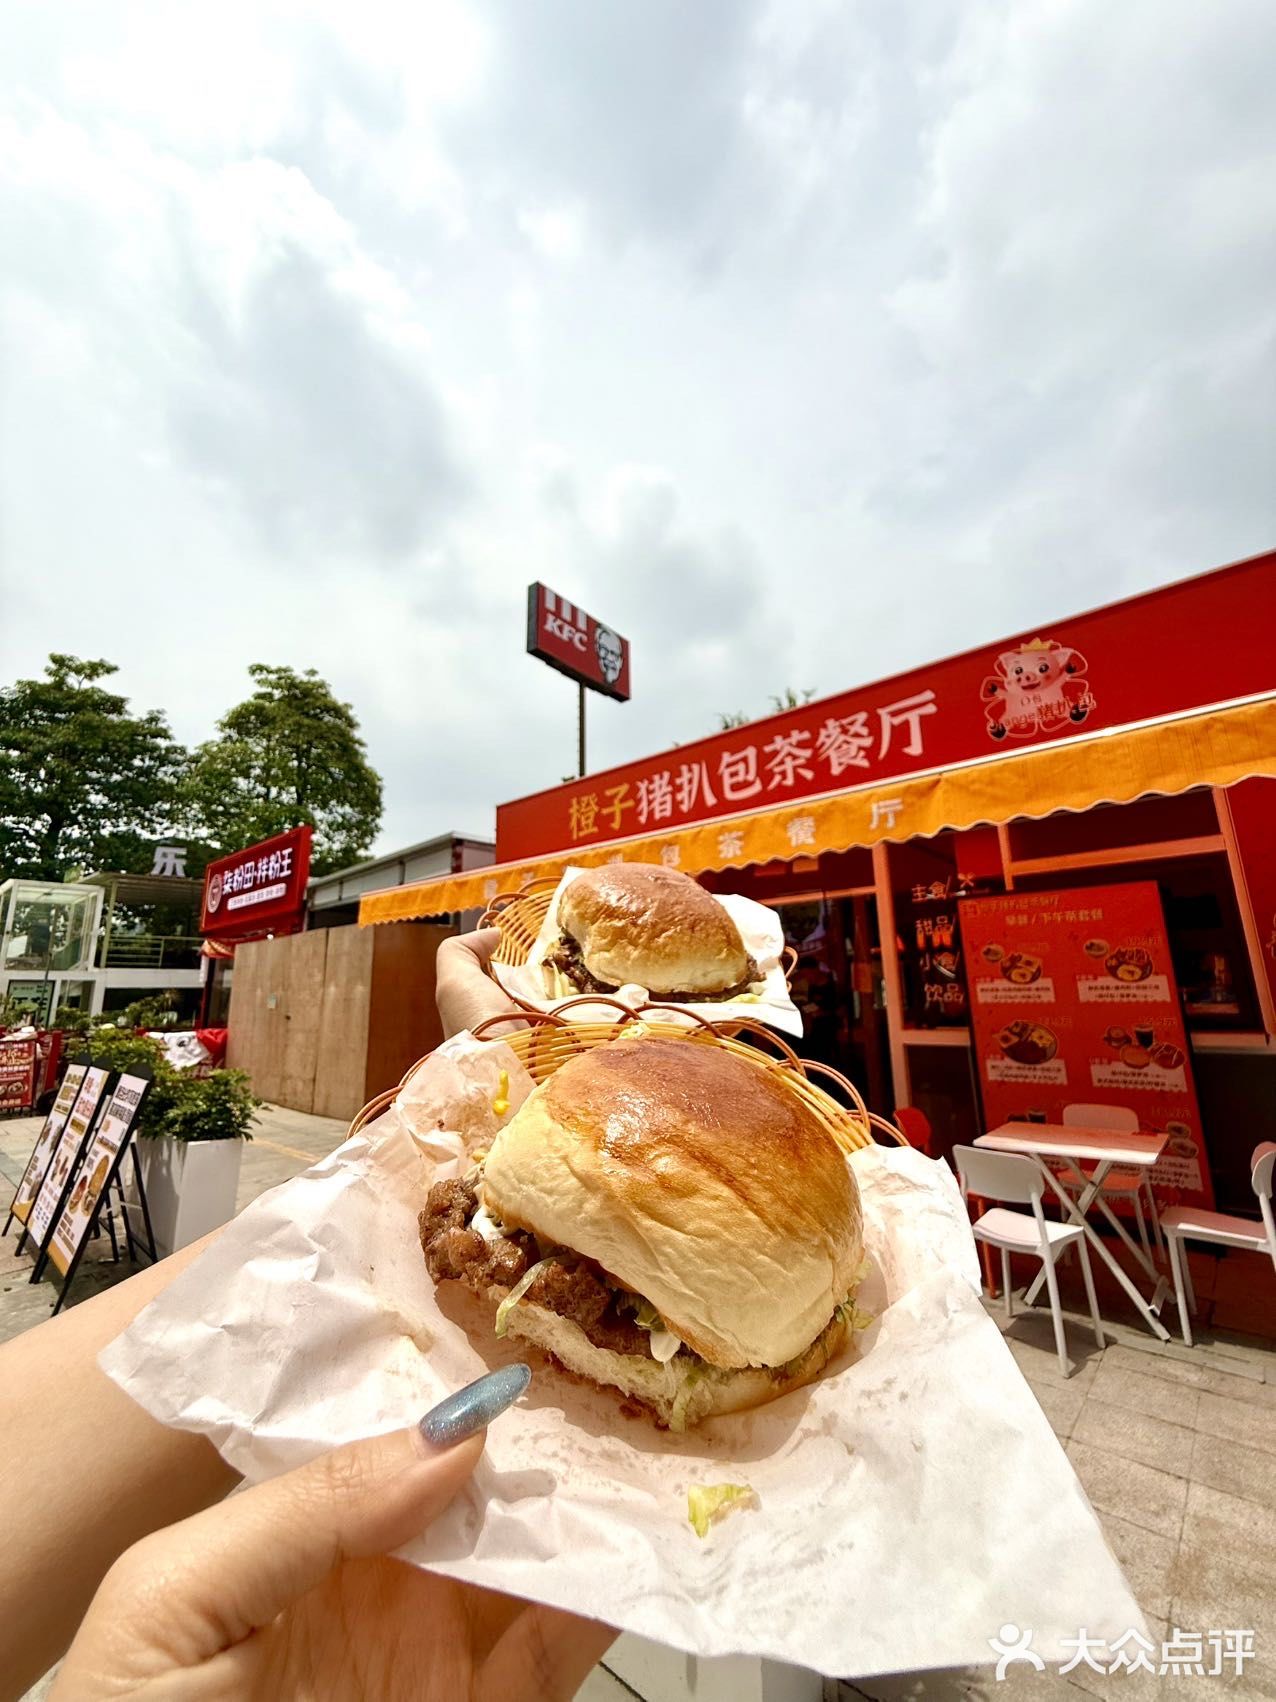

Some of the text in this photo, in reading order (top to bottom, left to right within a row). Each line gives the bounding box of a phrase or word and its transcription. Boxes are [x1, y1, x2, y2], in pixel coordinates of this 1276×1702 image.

[544, 612, 588, 652] KFC
[569, 689, 938, 841] 橙子猪扒包茶餐厅
